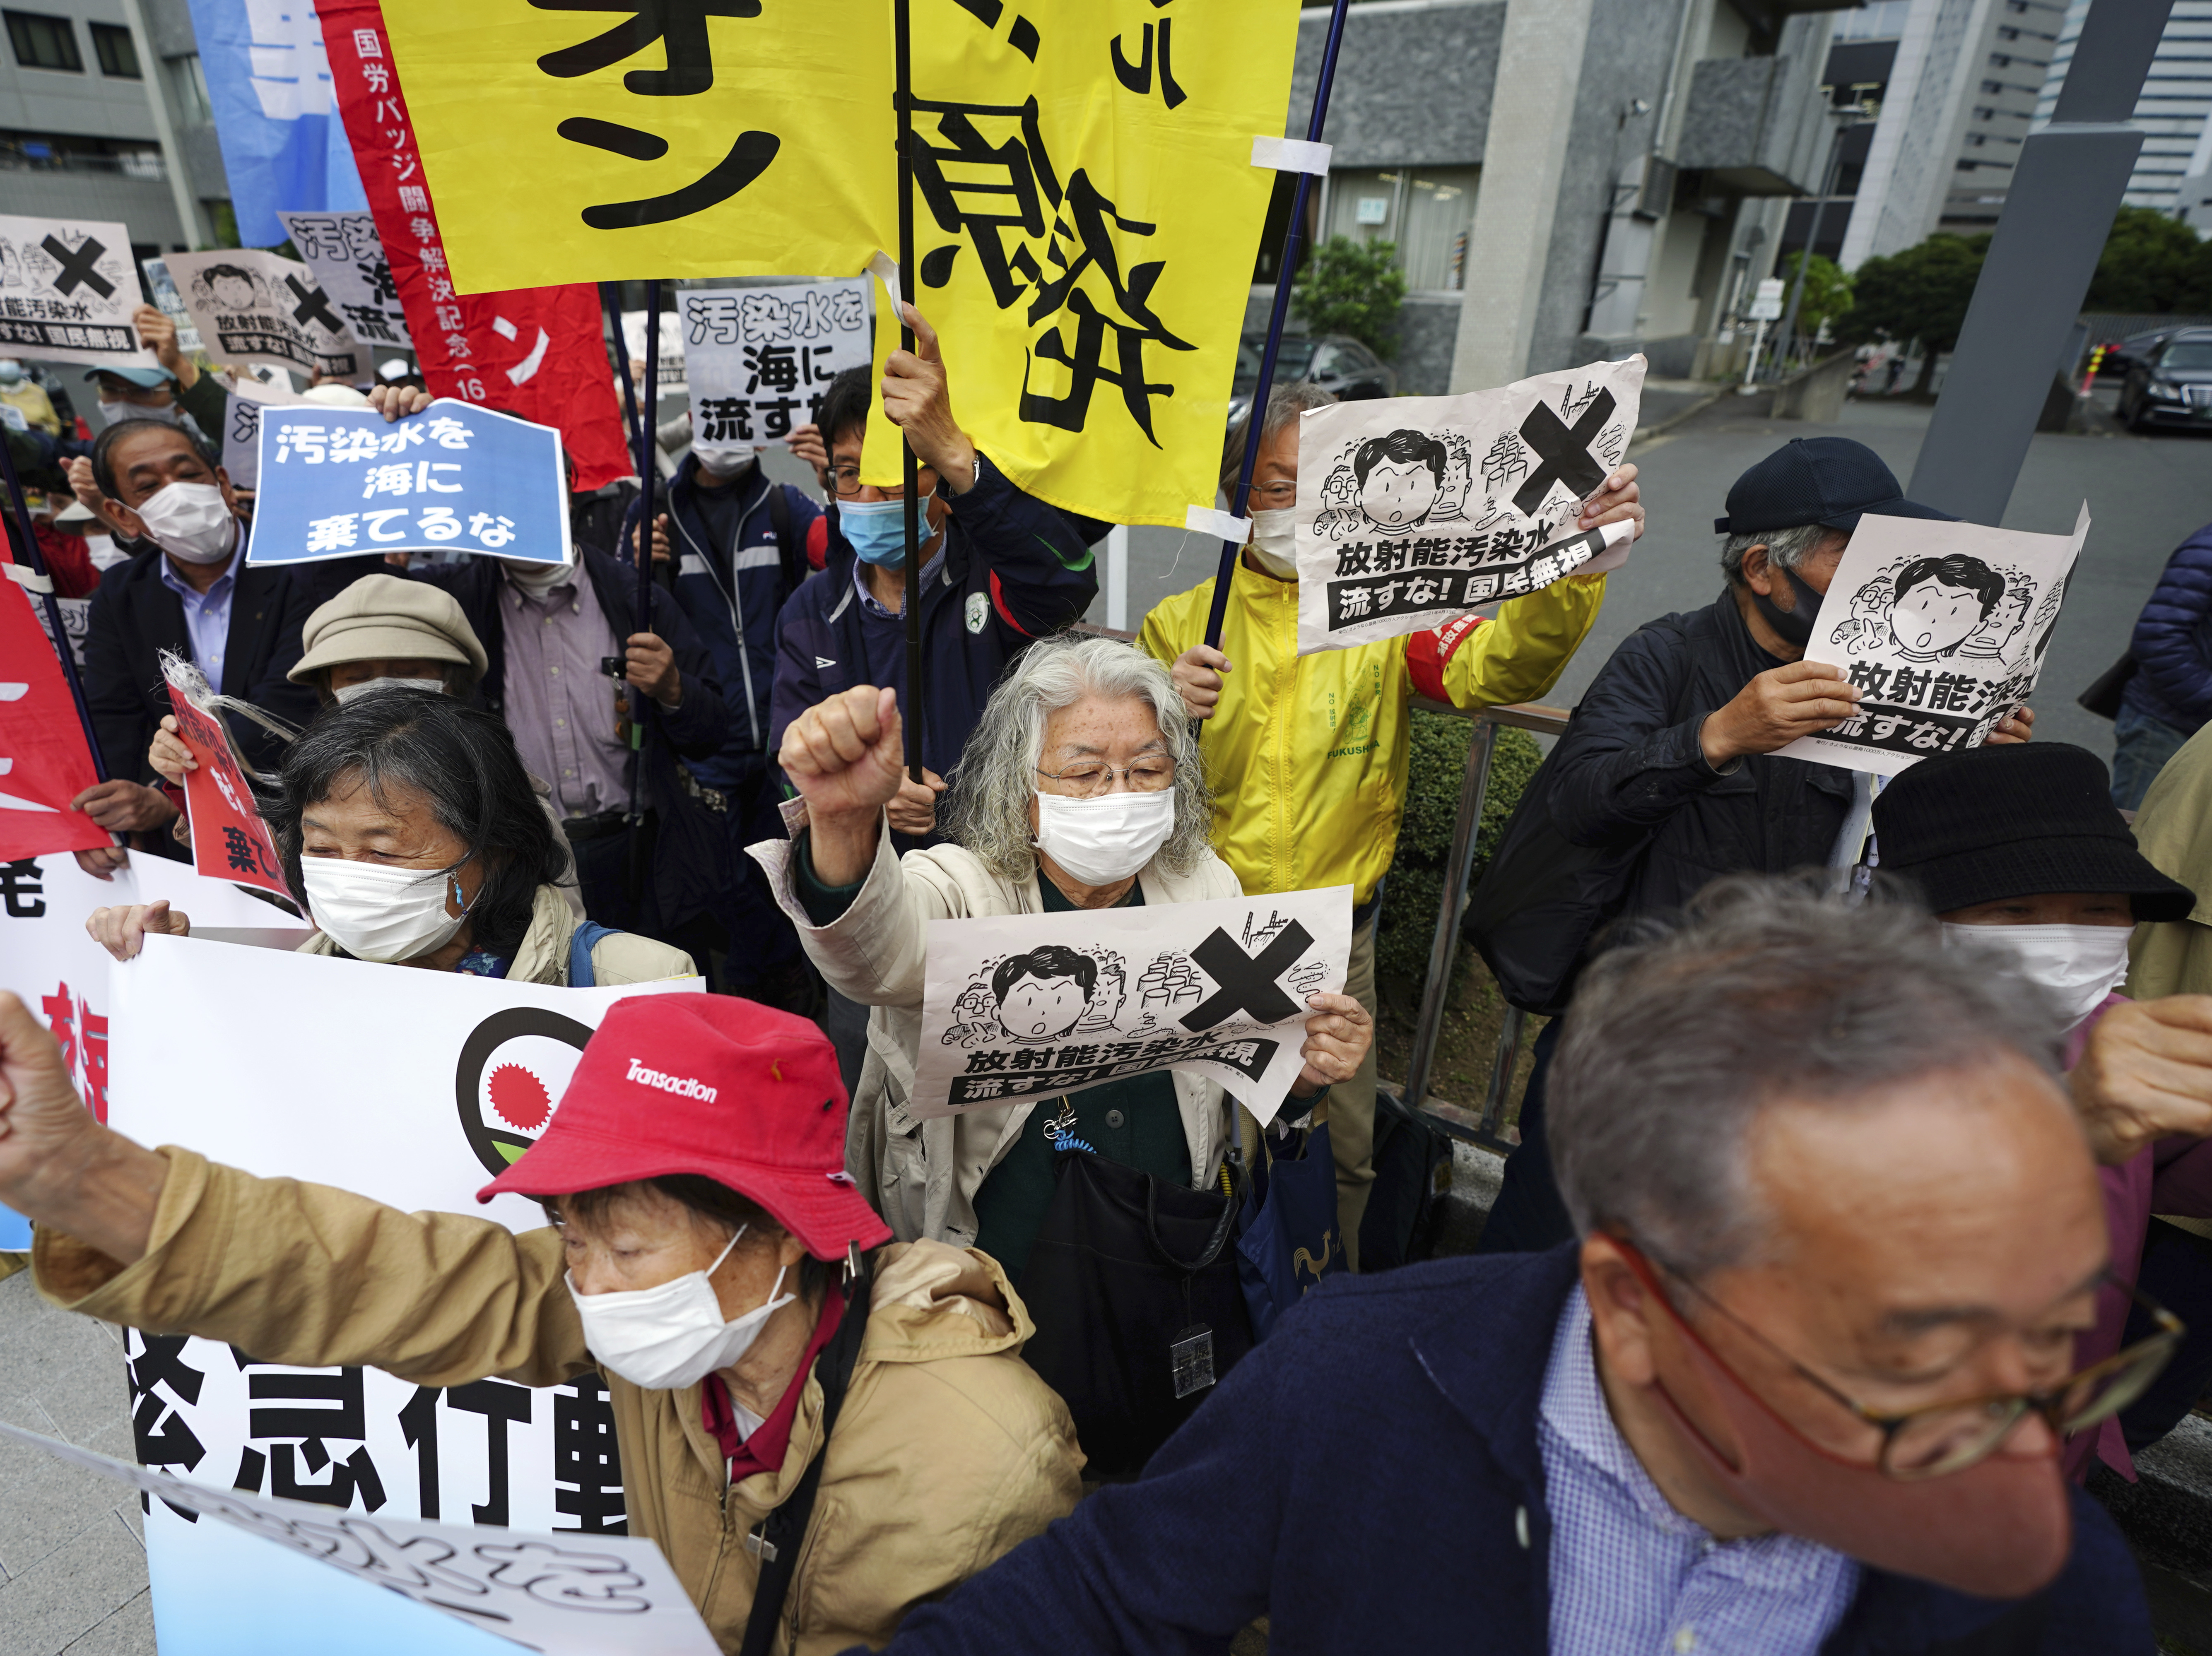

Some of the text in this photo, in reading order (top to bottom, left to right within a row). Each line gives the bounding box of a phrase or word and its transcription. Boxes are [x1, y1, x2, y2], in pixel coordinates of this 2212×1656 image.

[687, 289, 863, 345] 汚染水を
[742, 344, 837, 394] 海に
[275, 416, 475, 464] 汚染水を
[362, 460, 464, 499] 海に
[306, 506, 516, 553] 棄てるな
[1335, 519, 1554, 577] 放射能汚染水
[1327, 739, 1380, 760] FUKUSHMA
[965, 1031, 1224, 1074] 放射能汚染水
[626, 1058, 718, 1104] Transaction
